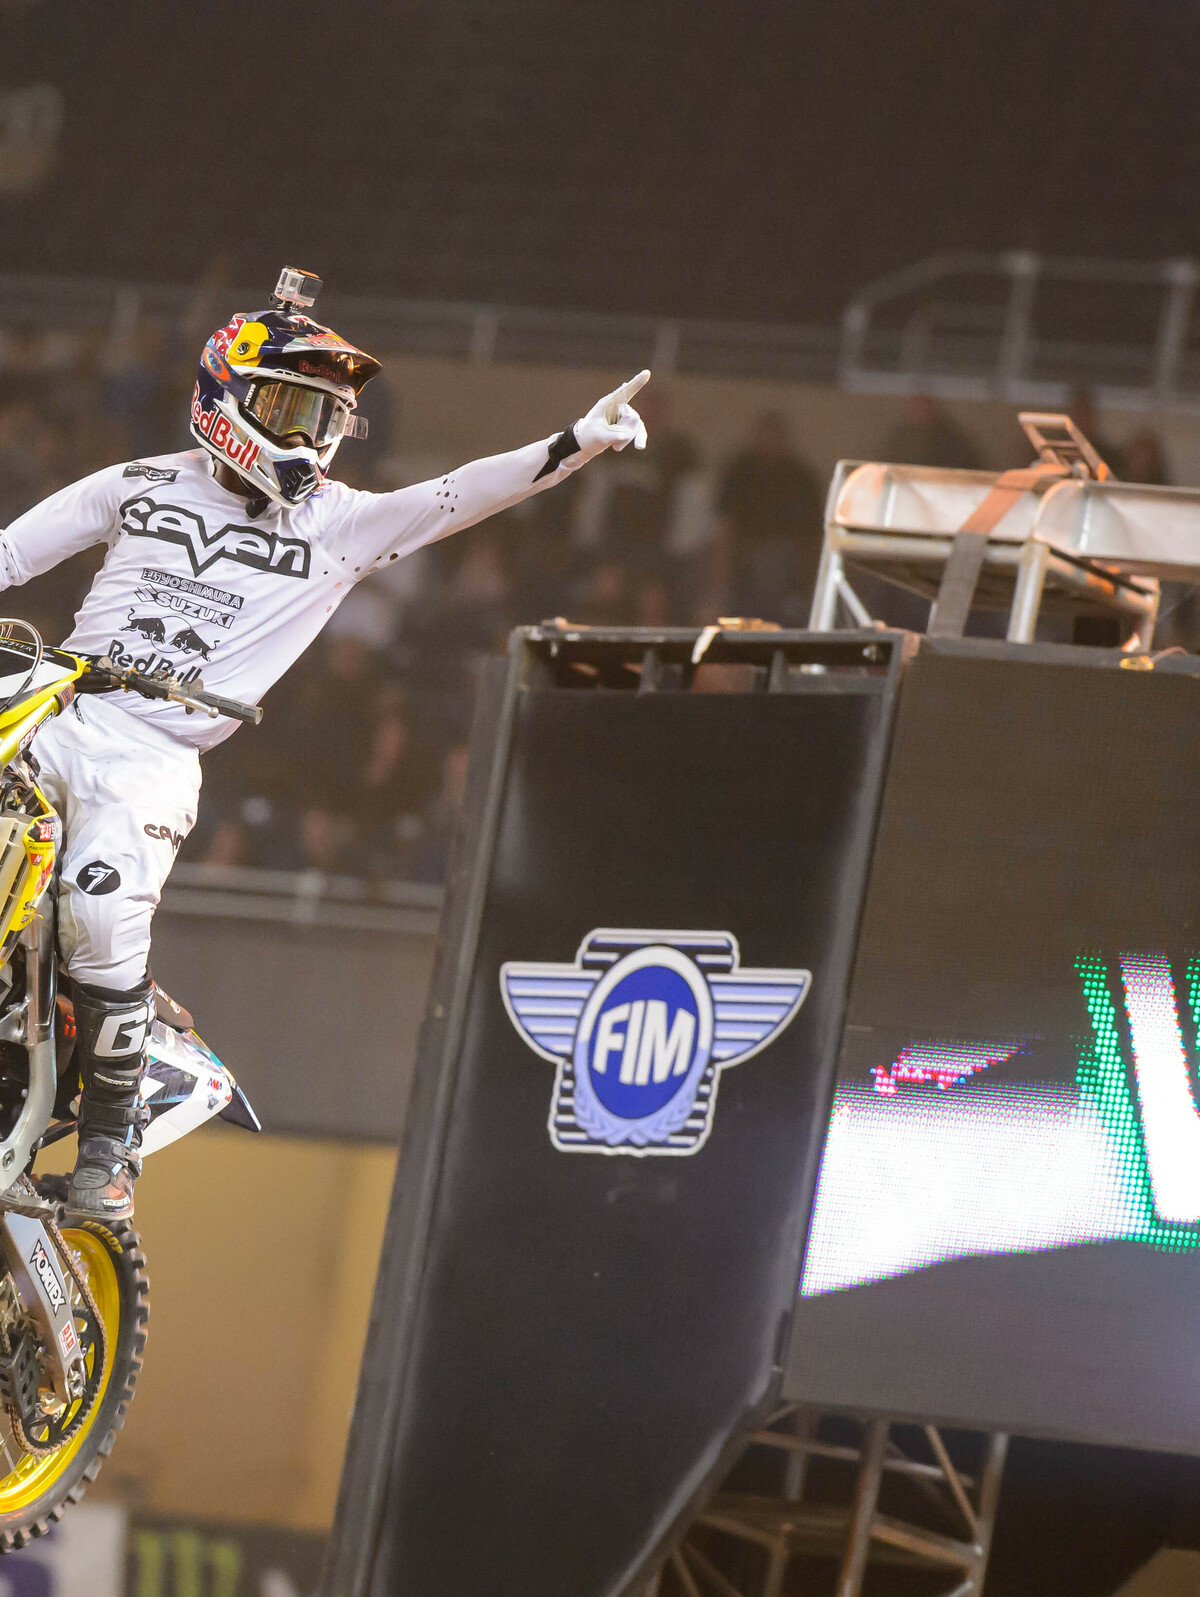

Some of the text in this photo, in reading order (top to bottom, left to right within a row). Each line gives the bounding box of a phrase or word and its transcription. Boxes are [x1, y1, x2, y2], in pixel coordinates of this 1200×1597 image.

[155, 591, 235, 629] SUZUKI
[159, 575, 243, 609] YOSHIMURA
[593, 999, 696, 1086] FIM
[29, 1238, 67, 1318] VORTEX
